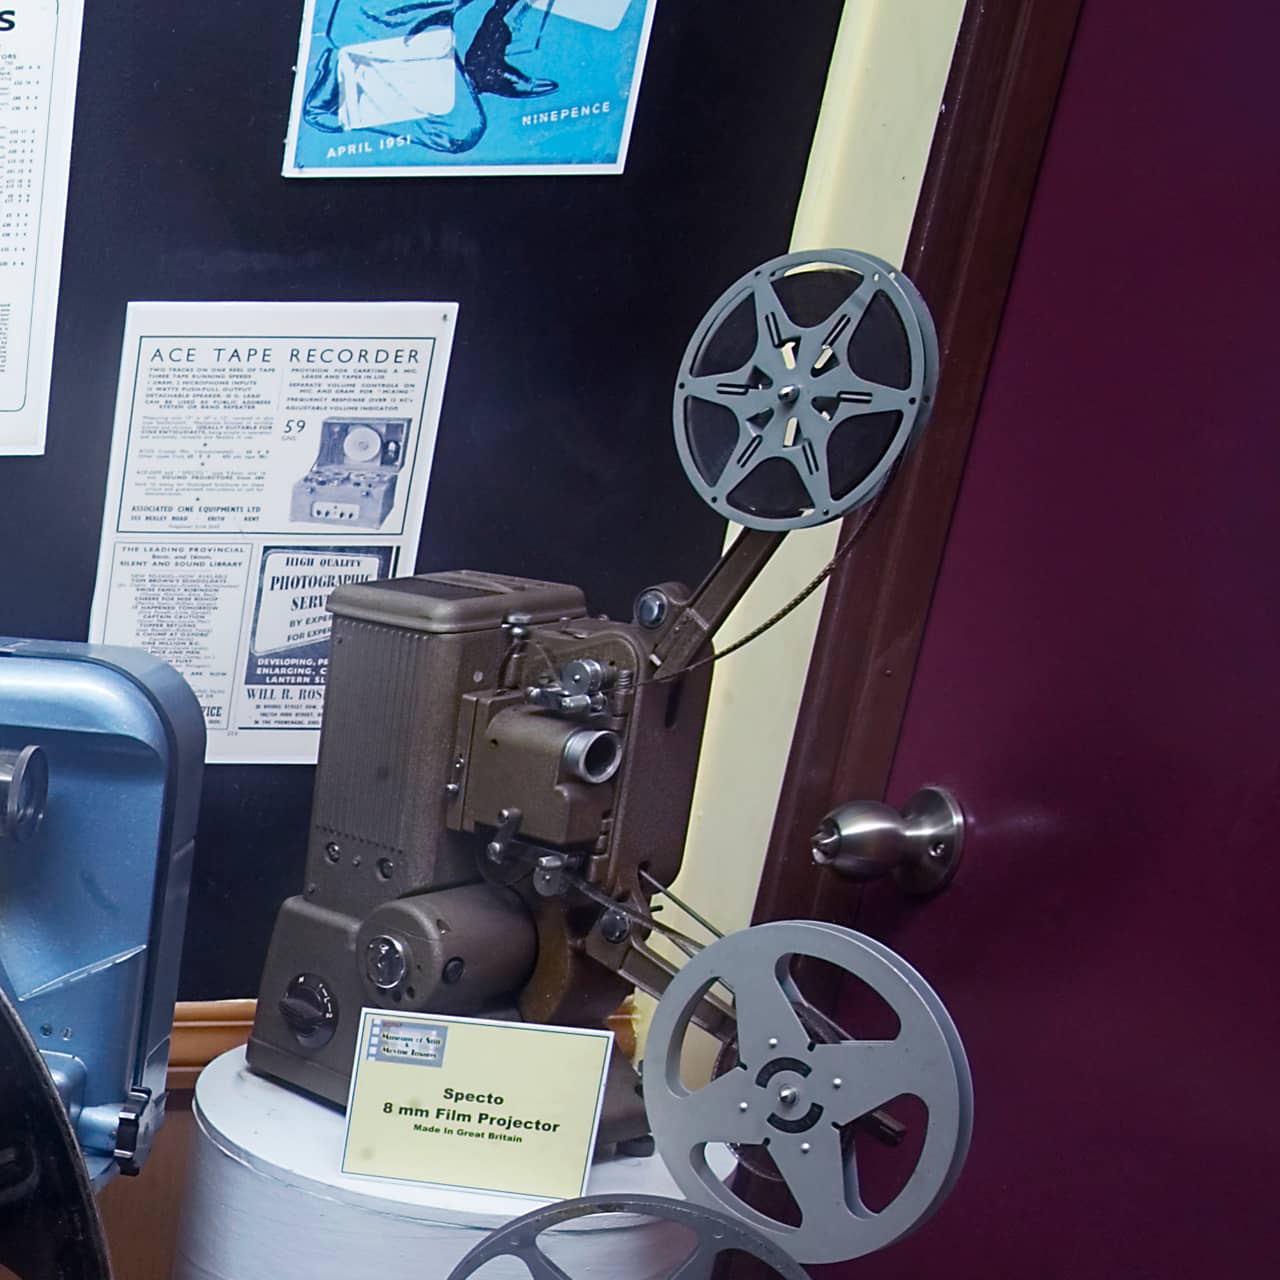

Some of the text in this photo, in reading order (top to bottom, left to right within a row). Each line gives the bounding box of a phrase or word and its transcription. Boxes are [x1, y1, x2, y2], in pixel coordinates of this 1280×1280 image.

[522, 102, 611, 126] NINEPENCE
[327, 135, 411, 158] APRIL 1951
[151, 348, 420, 363] ACE TAPE RECORDER
[285, 557, 361, 568] HIGH QUALITY
[443, 1088, 504, 1105] Specto
[383, 1102, 560, 1132] 8 mm Film Projector
[414, 1124, 522, 1143] Made In Great Britain
